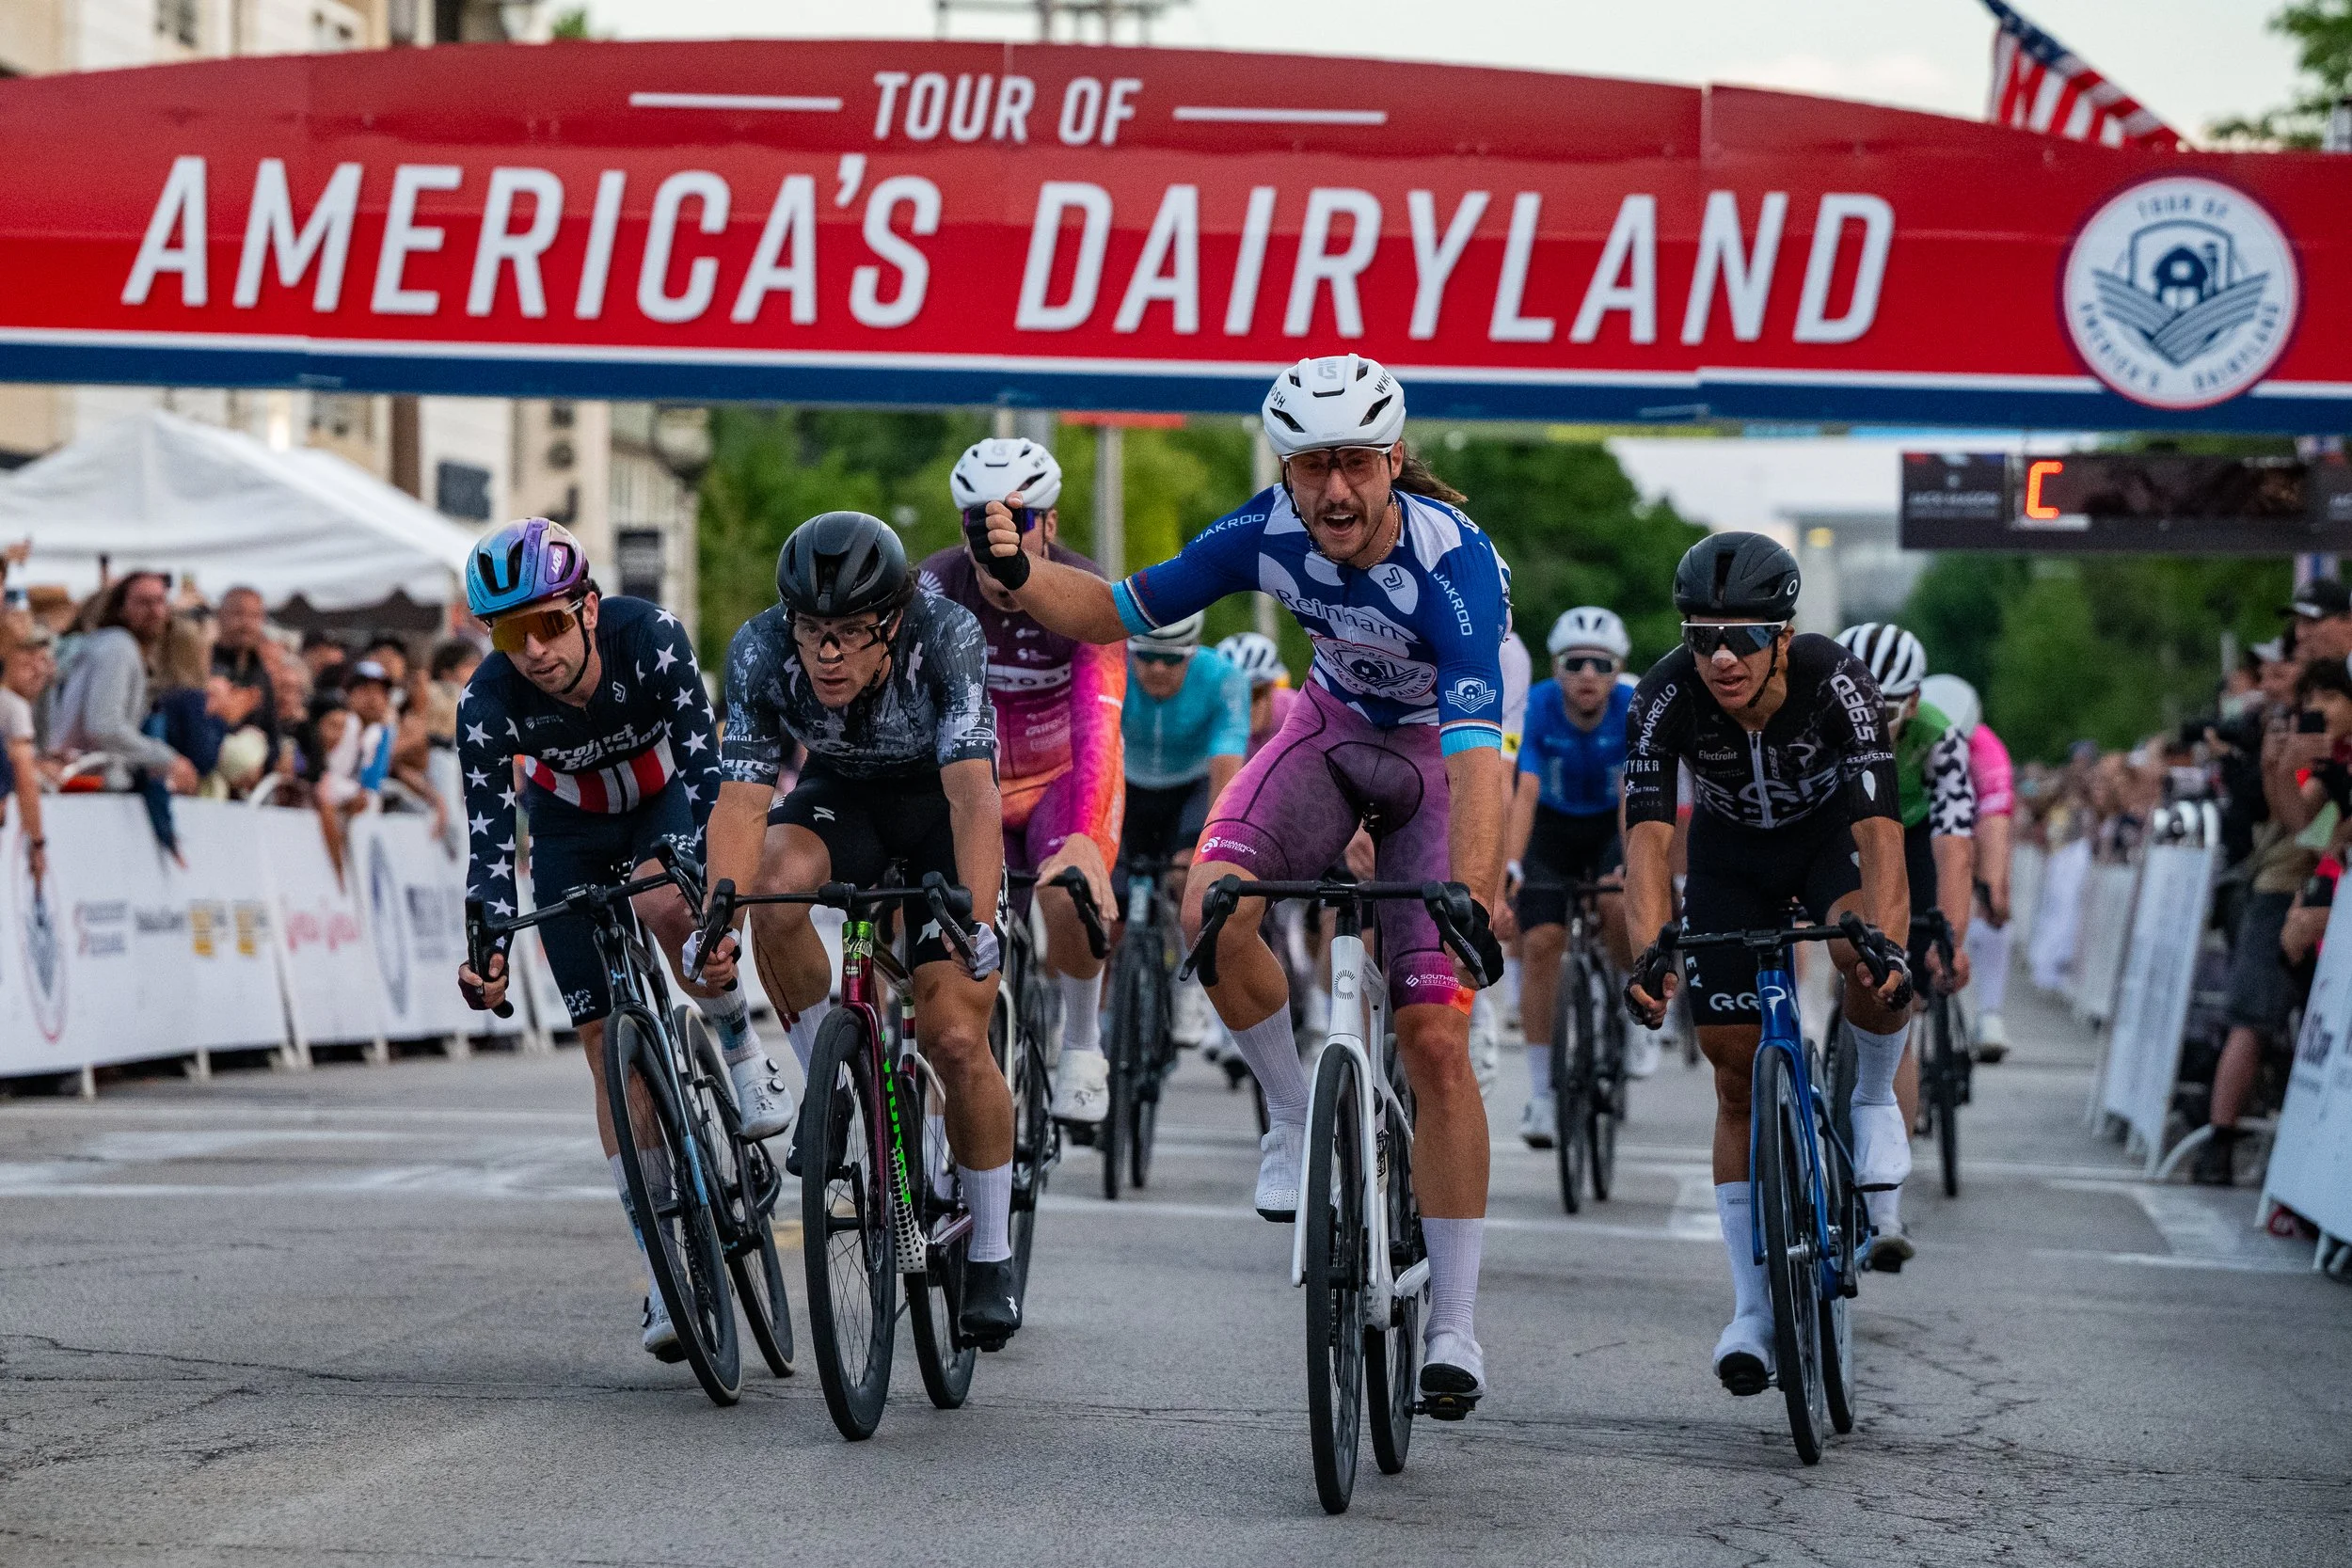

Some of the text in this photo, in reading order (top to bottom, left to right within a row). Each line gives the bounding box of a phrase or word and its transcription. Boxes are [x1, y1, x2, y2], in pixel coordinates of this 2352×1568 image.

[873, 71, 1144, 146] TOUR OF
[120, 153, 1895, 345] AMERICA'S DAIRYLAND
[1196, 515, 1265, 543] JAKROO
[1433, 572, 1473, 636] JAKROO
[1639, 684, 1677, 756] PINARELLO
[541, 722, 635, 761] Project
[1218, 843, 1245, 853] SYSTEM
[1220, 839, 1257, 855] CHAMPION
[1420, 974, 1459, 984] SOUTHER
